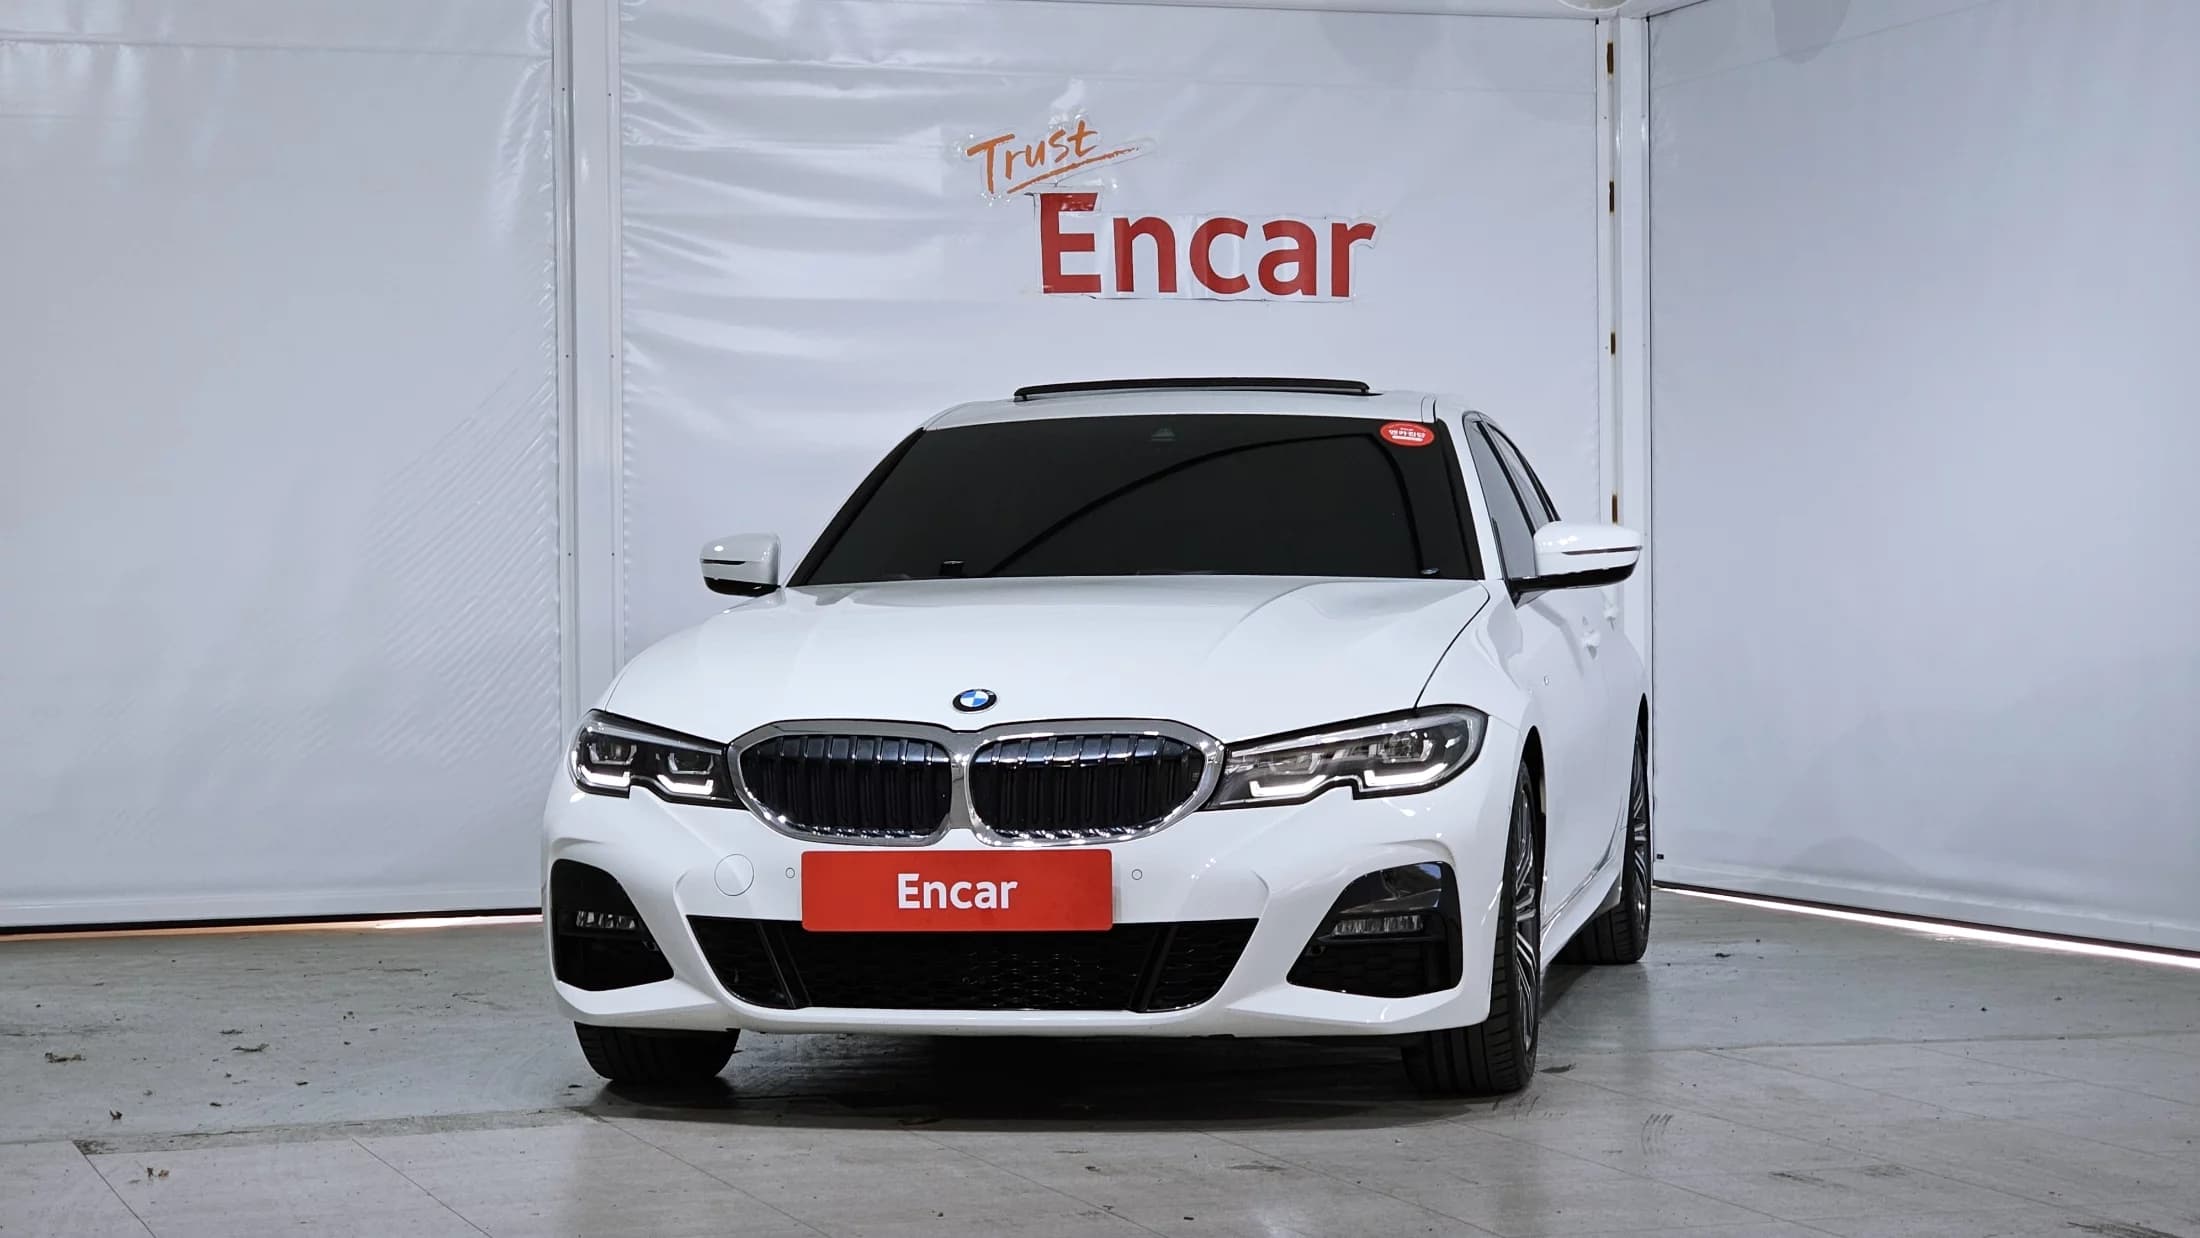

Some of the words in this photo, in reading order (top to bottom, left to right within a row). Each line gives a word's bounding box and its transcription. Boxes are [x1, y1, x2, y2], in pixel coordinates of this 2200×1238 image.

[967, 119, 1099, 194] Trust
[1040, 192, 1377, 297] Encar
[897, 873, 1018, 909] Encar
